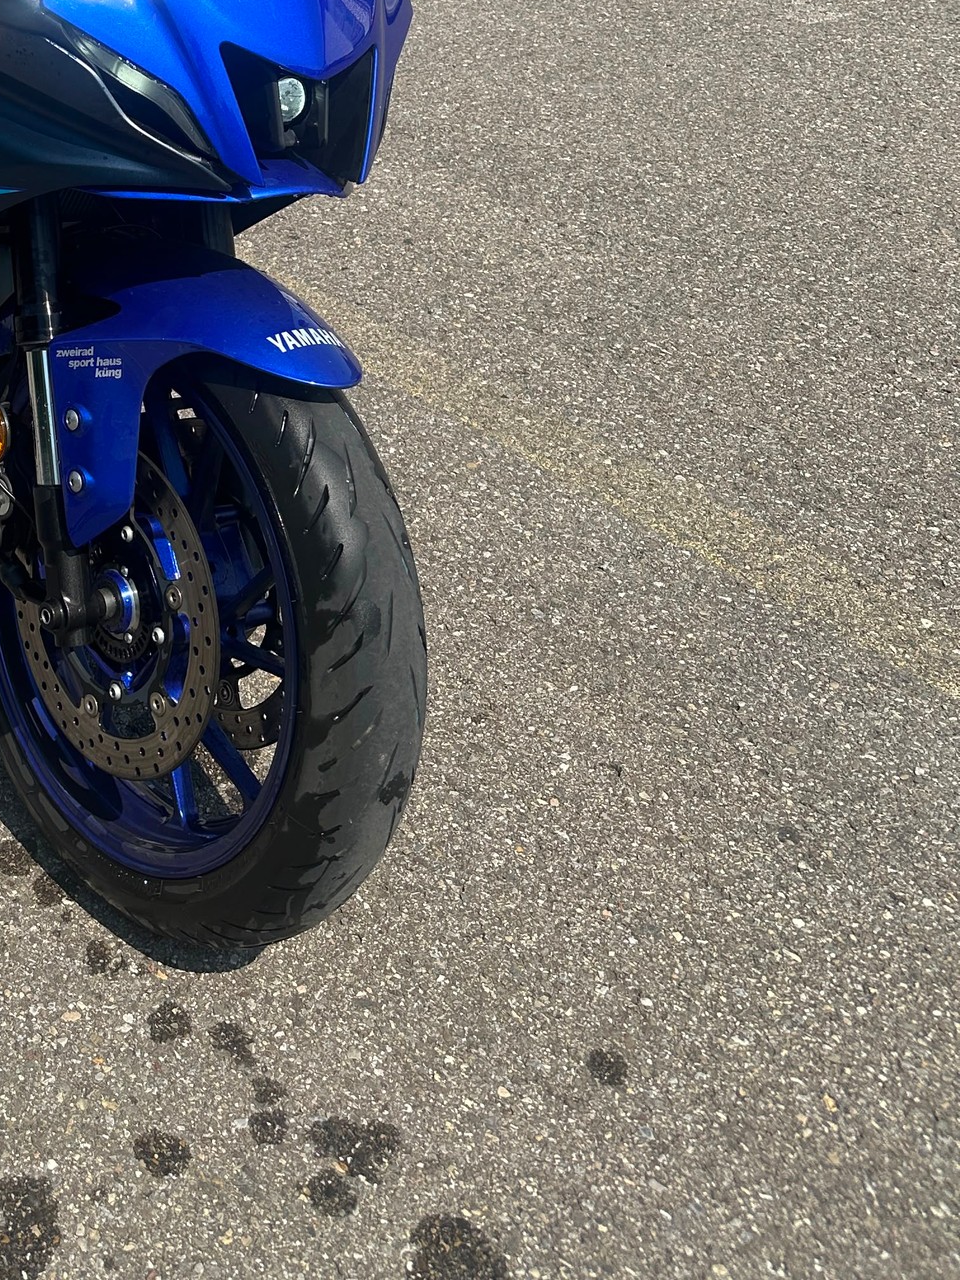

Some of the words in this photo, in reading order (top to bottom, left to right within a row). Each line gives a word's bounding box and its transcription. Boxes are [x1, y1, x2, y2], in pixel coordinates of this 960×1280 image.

[266, 328, 346, 353] YAMAHA
[56, 346, 94, 358] zweirad
[68, 358, 94, 370] sport
[96, 357, 122, 367] haus
[94, 367, 122, 379] küng
